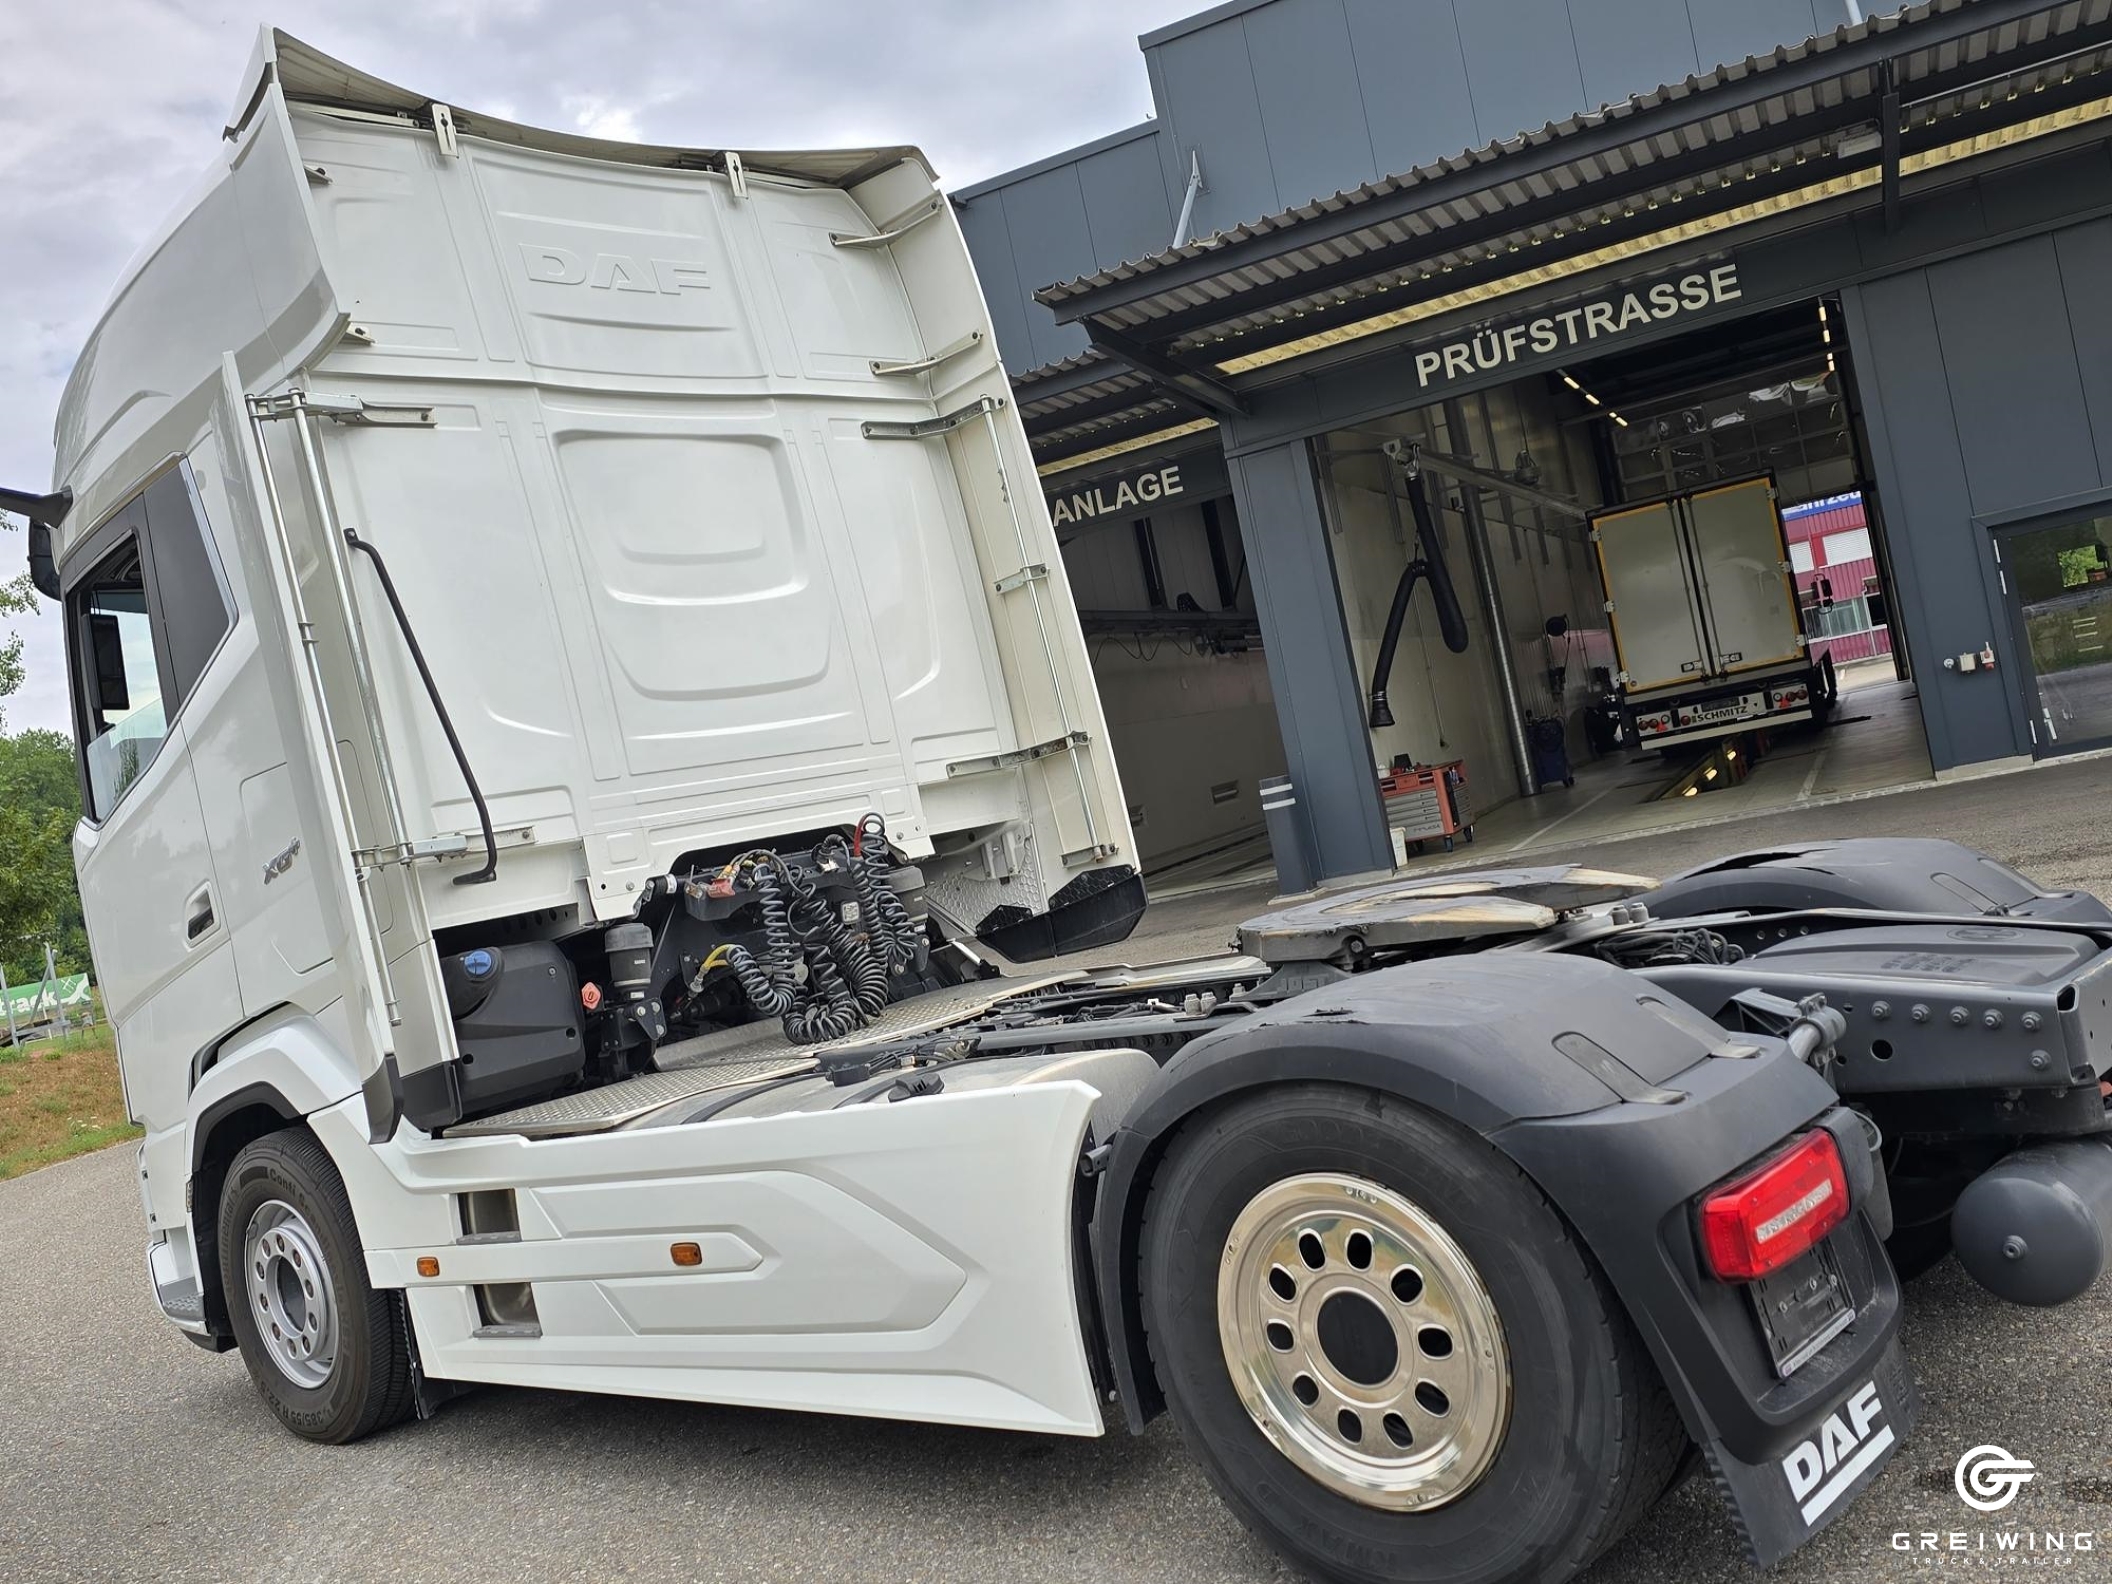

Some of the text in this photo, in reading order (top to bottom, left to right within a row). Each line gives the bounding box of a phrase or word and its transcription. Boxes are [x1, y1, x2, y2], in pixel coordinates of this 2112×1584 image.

[518, 243, 711, 296] DAF
[1414, 263, 1742, 388] PRÜFSTRASSE
[1053, 466, 1184, 527] ANLAGE
[1695, 706, 1748, 722] SCHMITZ
[268, 1168, 297, 1197] Conti
[1782, 1380, 1882, 1503] DAF
